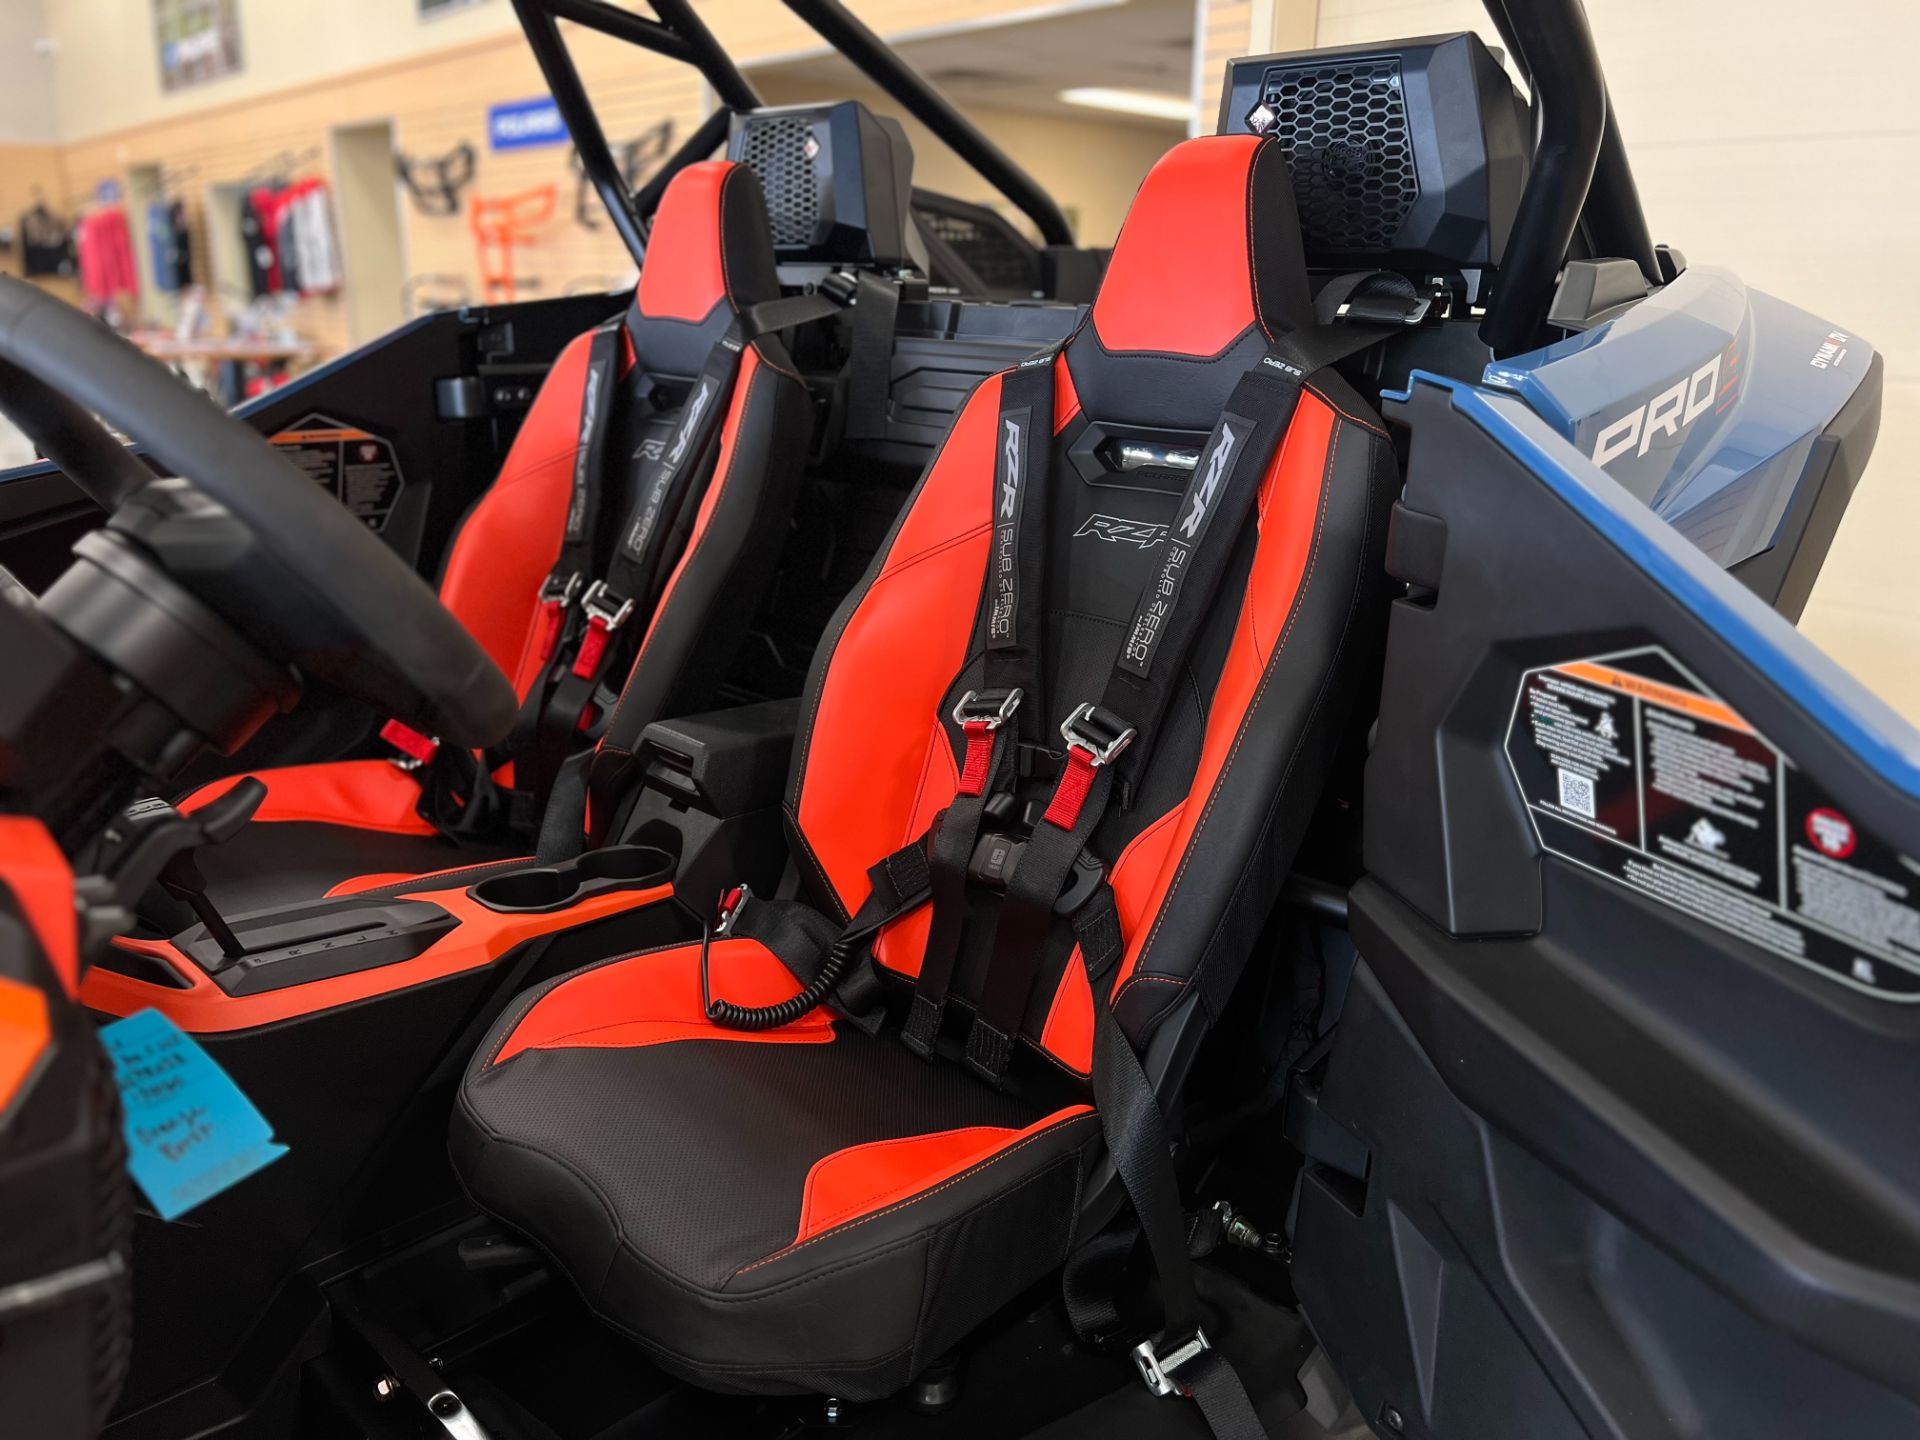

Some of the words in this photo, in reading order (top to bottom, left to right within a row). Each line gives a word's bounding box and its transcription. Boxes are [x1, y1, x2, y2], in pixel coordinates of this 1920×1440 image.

[1591, 353, 1722, 469] PRO
[651, 469, 672, 504] SUB
[1000, 419, 1020, 519] RZR
[1179, 422, 1236, 539] RZR
[1002, 528, 1014, 573] SUB
[1161, 547, 1187, 597] SUB
[999, 577, 1014, 635] ZERO
[1134, 600, 1169, 662] ZERO
